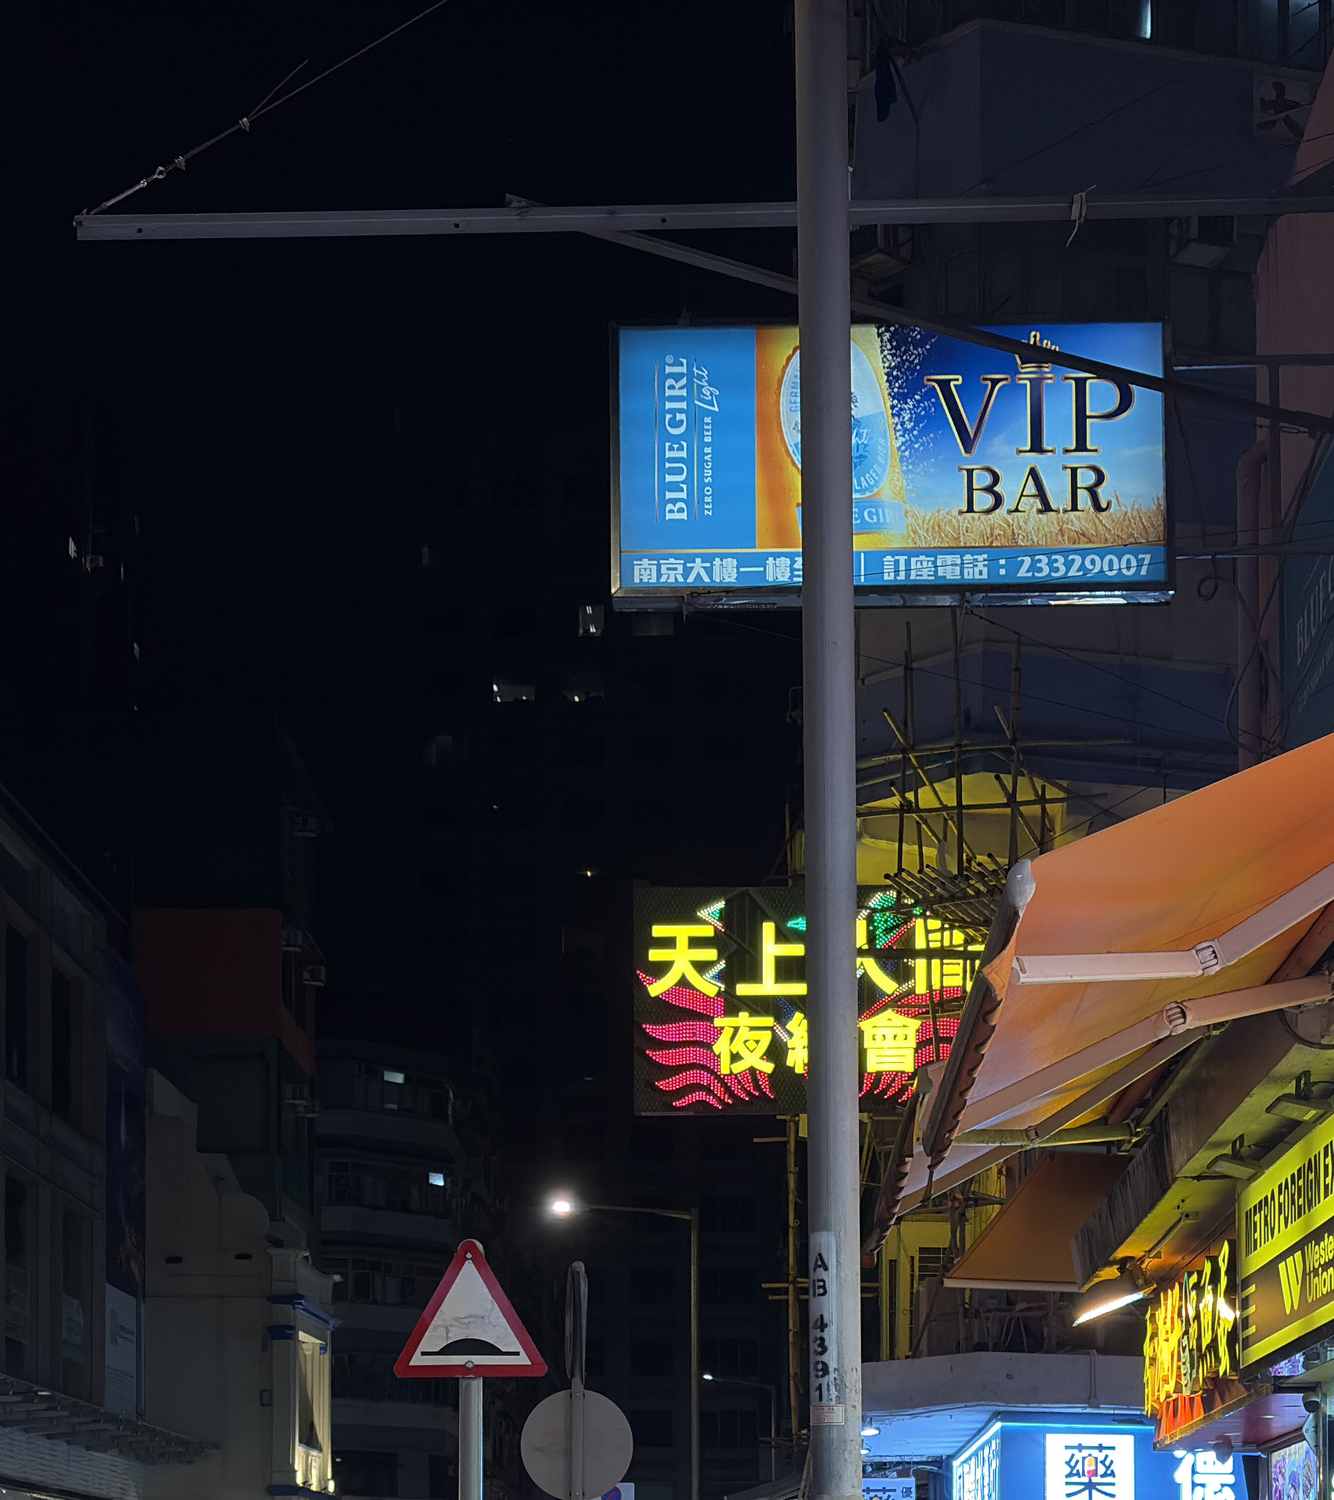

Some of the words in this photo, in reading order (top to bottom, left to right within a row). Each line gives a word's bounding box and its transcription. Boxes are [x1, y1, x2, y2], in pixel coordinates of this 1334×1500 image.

[693, 365, 720, 412] Light
[704, 416, 713, 442] BEER
[924, 372, 1137, 457] VIP
[665, 440, 688, 521] BLUE
[704, 446, 713, 483] SUGAR
[704, 486, 713, 516] ZERO
[956, 464, 1113, 517] BAR
[1015, 553, 1152, 578] 23329007
[1245, 1188, 1277, 1258] METRO
[1278, 1150, 1321, 1235] FOREIGN
[1306, 1266, 1334, 1303] Union
